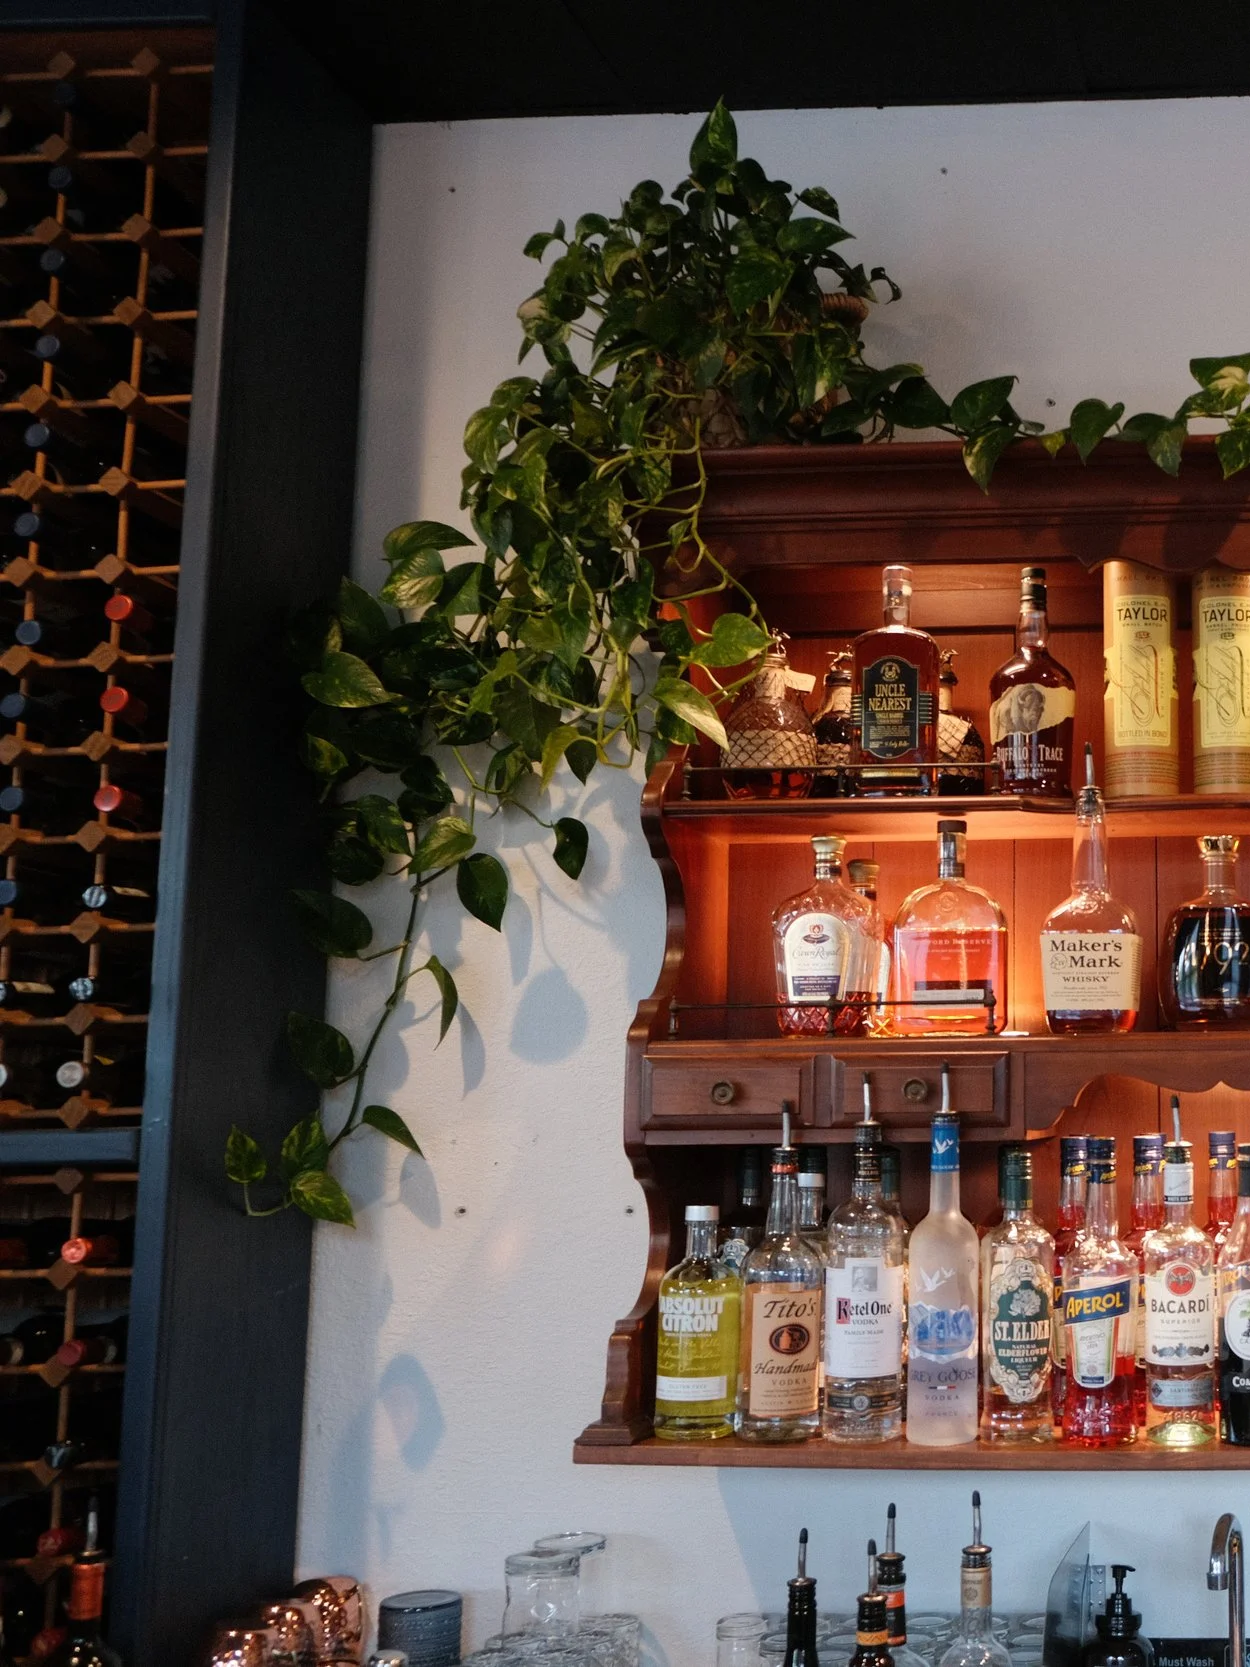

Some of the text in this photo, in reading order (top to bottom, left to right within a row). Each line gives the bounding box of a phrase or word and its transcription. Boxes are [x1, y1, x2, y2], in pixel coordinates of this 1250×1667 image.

[1116, 607, 1169, 623] TAYLOR
[875, 683, 906, 697] UNCLE
[868, 697, 912, 711] NEAREST
[996, 744, 1064, 761] BUFFALO TRACE
[792, 945, 841, 960] Crown Royal
[1050, 939, 1123, 952] Maker's
[1069, 955, 1122, 968] Mark
[659, 1296, 726, 1315] ABSOLUT
[763, 1297, 817, 1318] Tito's
[837, 1300, 892, 1320] Ketel One
[1066, 1292, 1124, 1319] APEROL
[1151, 1294, 1210, 1314] BACARDÍ
[661, 1313, 719, 1332] CITRON
[852, 1318, 879, 1326] VODKA
[994, 1320, 1050, 1341] ST. ELDER
[998, 1347, 1048, 1357] ELDERFLOWER
[753, 1358, 817, 1375] Handmad
[771, 1378, 808, 1386] VODKA
[1159, 1656, 1214, 1667] Must Wash
